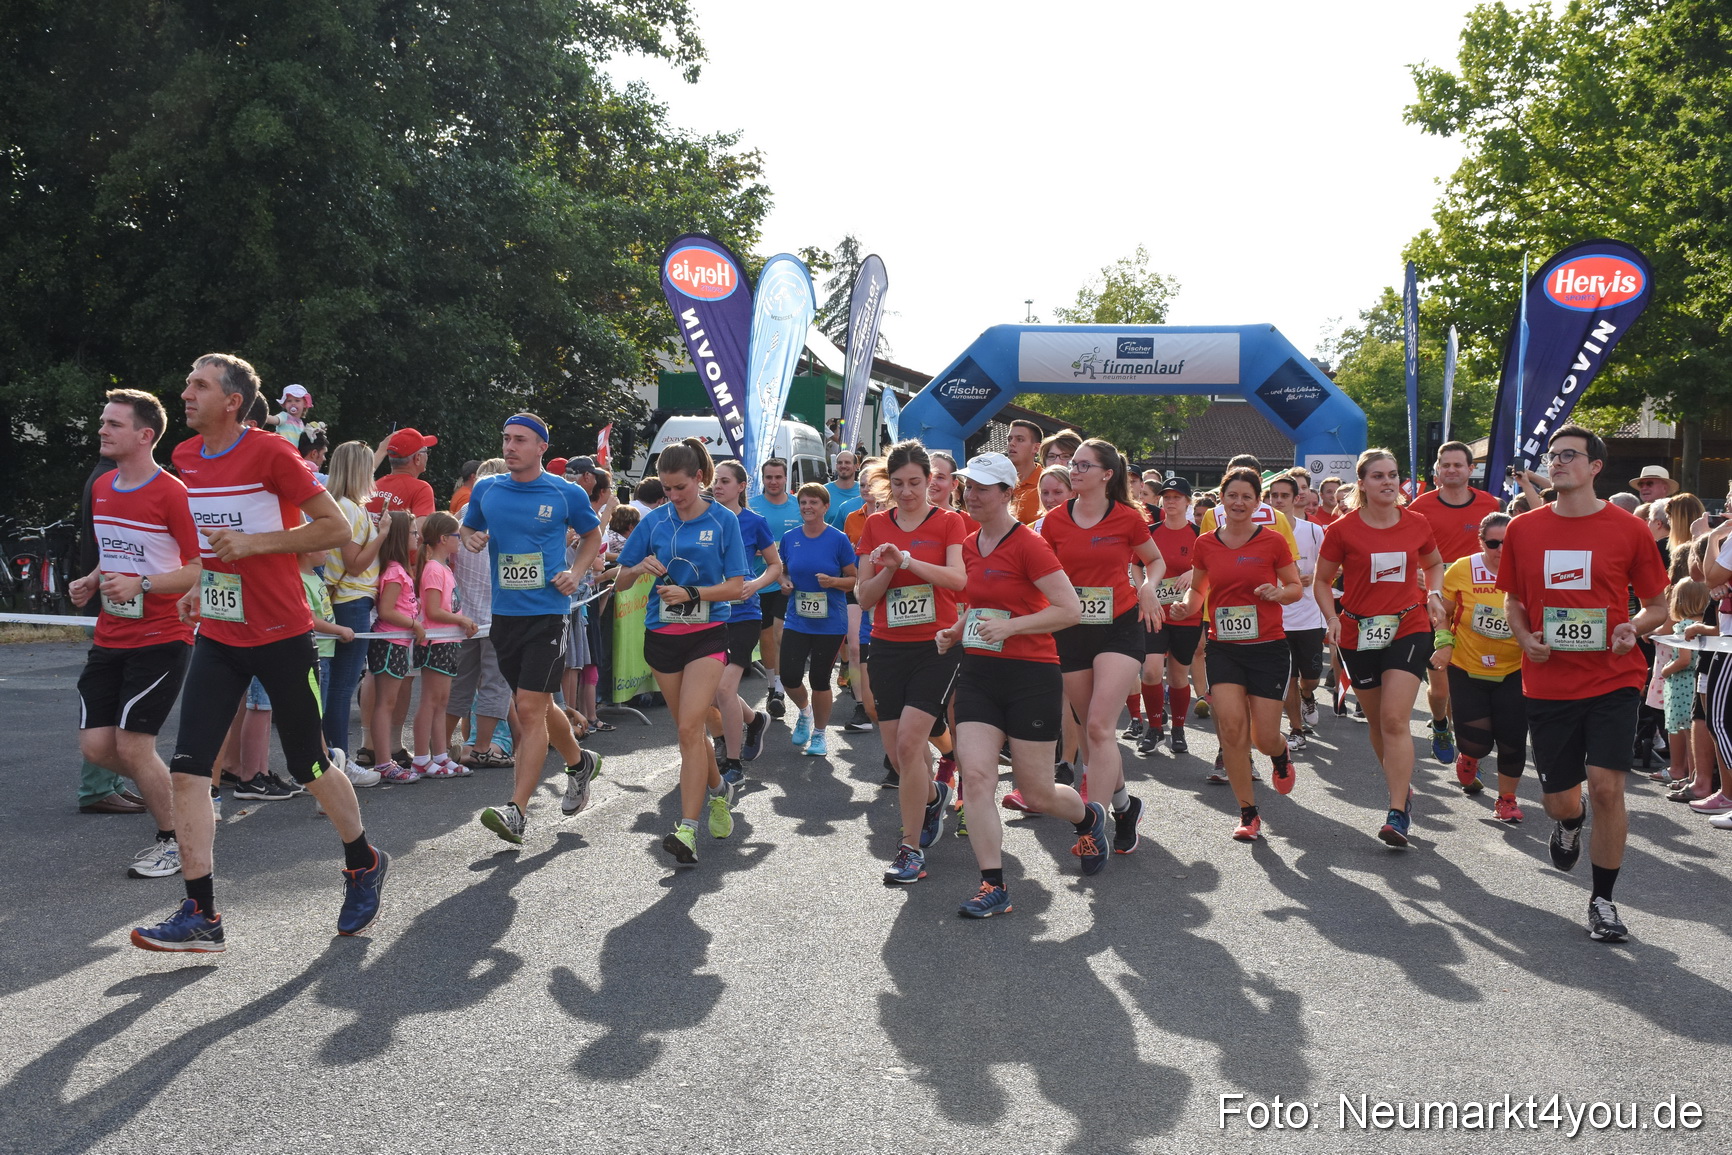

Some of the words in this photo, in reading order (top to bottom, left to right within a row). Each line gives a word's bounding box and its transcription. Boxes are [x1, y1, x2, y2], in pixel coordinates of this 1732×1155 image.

[1554, 269, 1636, 298] Hervis
[1104, 360, 1185, 374] firmenlauf
[948, 385, 991, 394] Fischer
[392, 496, 403, 505] SV
[194, 512, 242, 526] Petry
[102, 538, 144, 556] Petry
[502, 566, 538, 580] 2026
[205, 588, 236, 608] 1815
[801, 601, 819, 611] 579
[892, 598, 927, 616] 1027
[1080, 600, 1106, 614] 032
[1220, 618, 1251, 631] 1030
[1477, 616, 1510, 632] 1565
[1556, 623, 1592, 639] 489
[1366, 628, 1391, 640] 545
